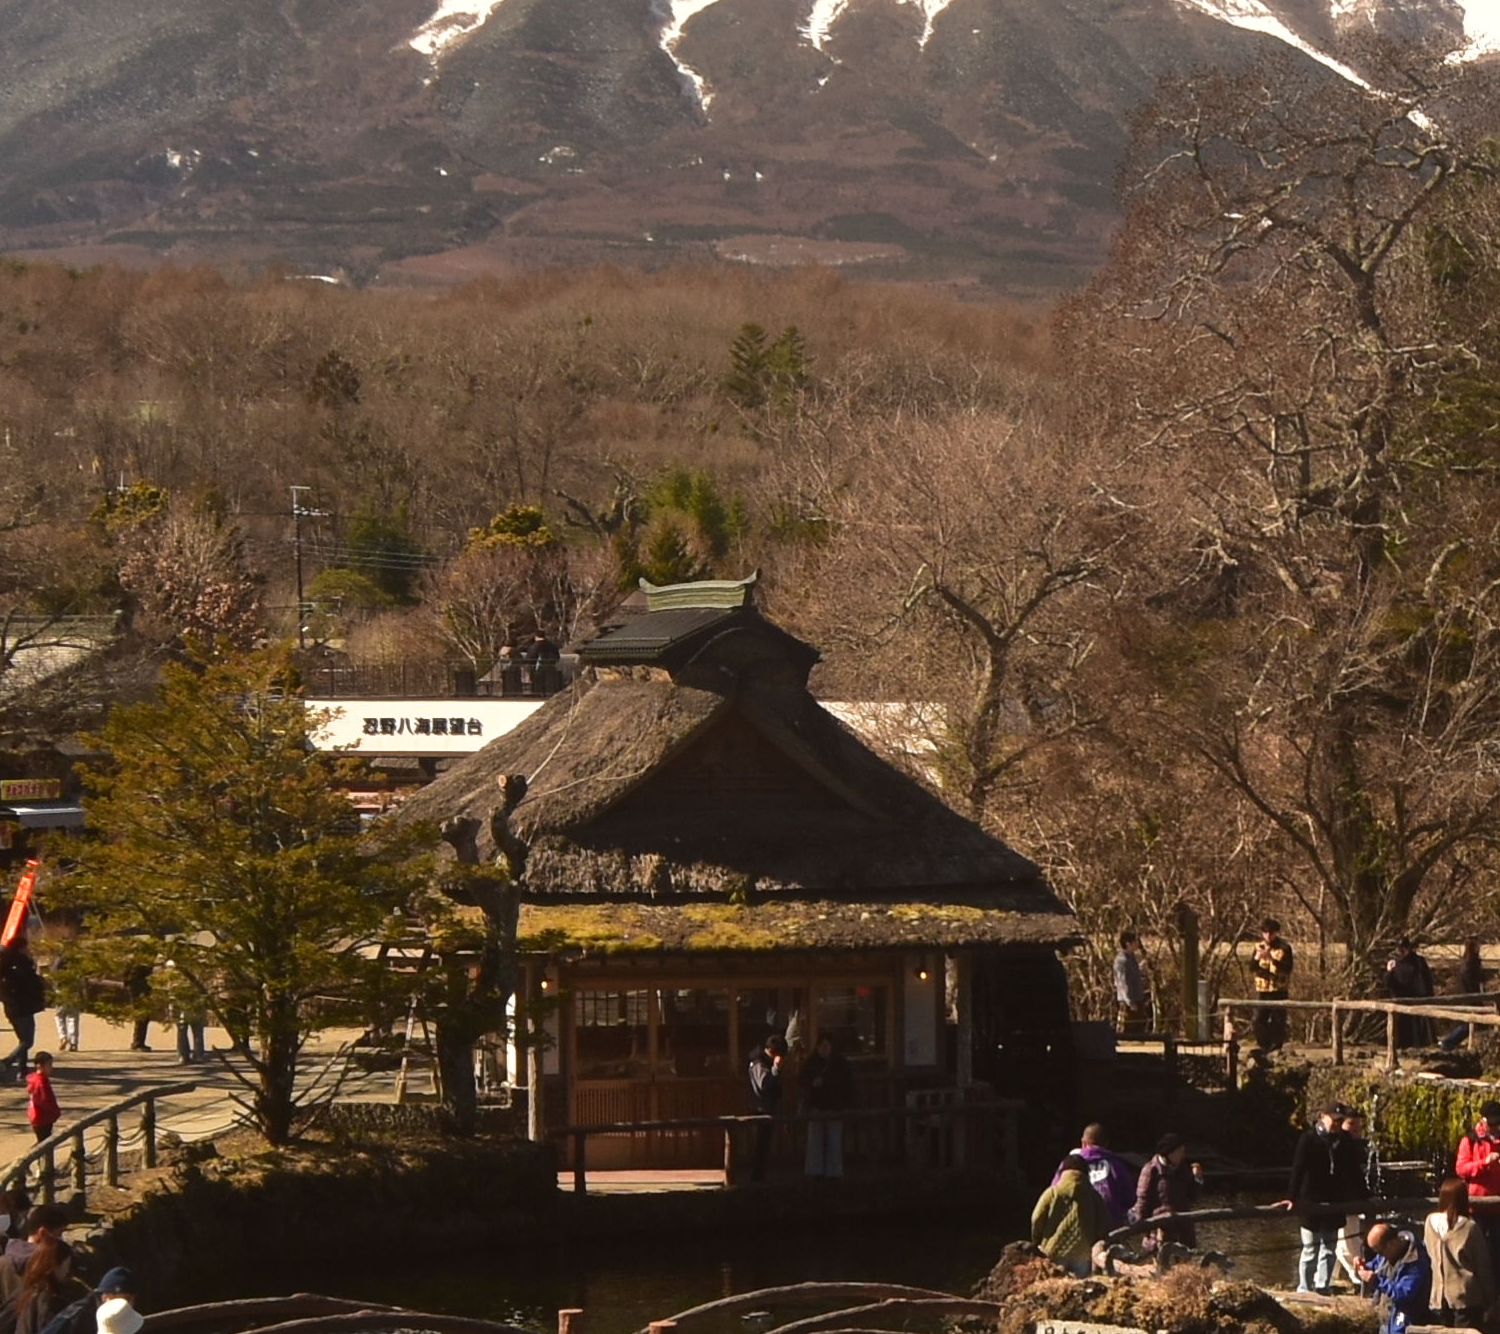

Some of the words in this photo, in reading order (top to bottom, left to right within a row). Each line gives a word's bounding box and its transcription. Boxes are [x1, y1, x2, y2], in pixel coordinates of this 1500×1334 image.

[362, 717, 483, 736] 忍野八海展望台
